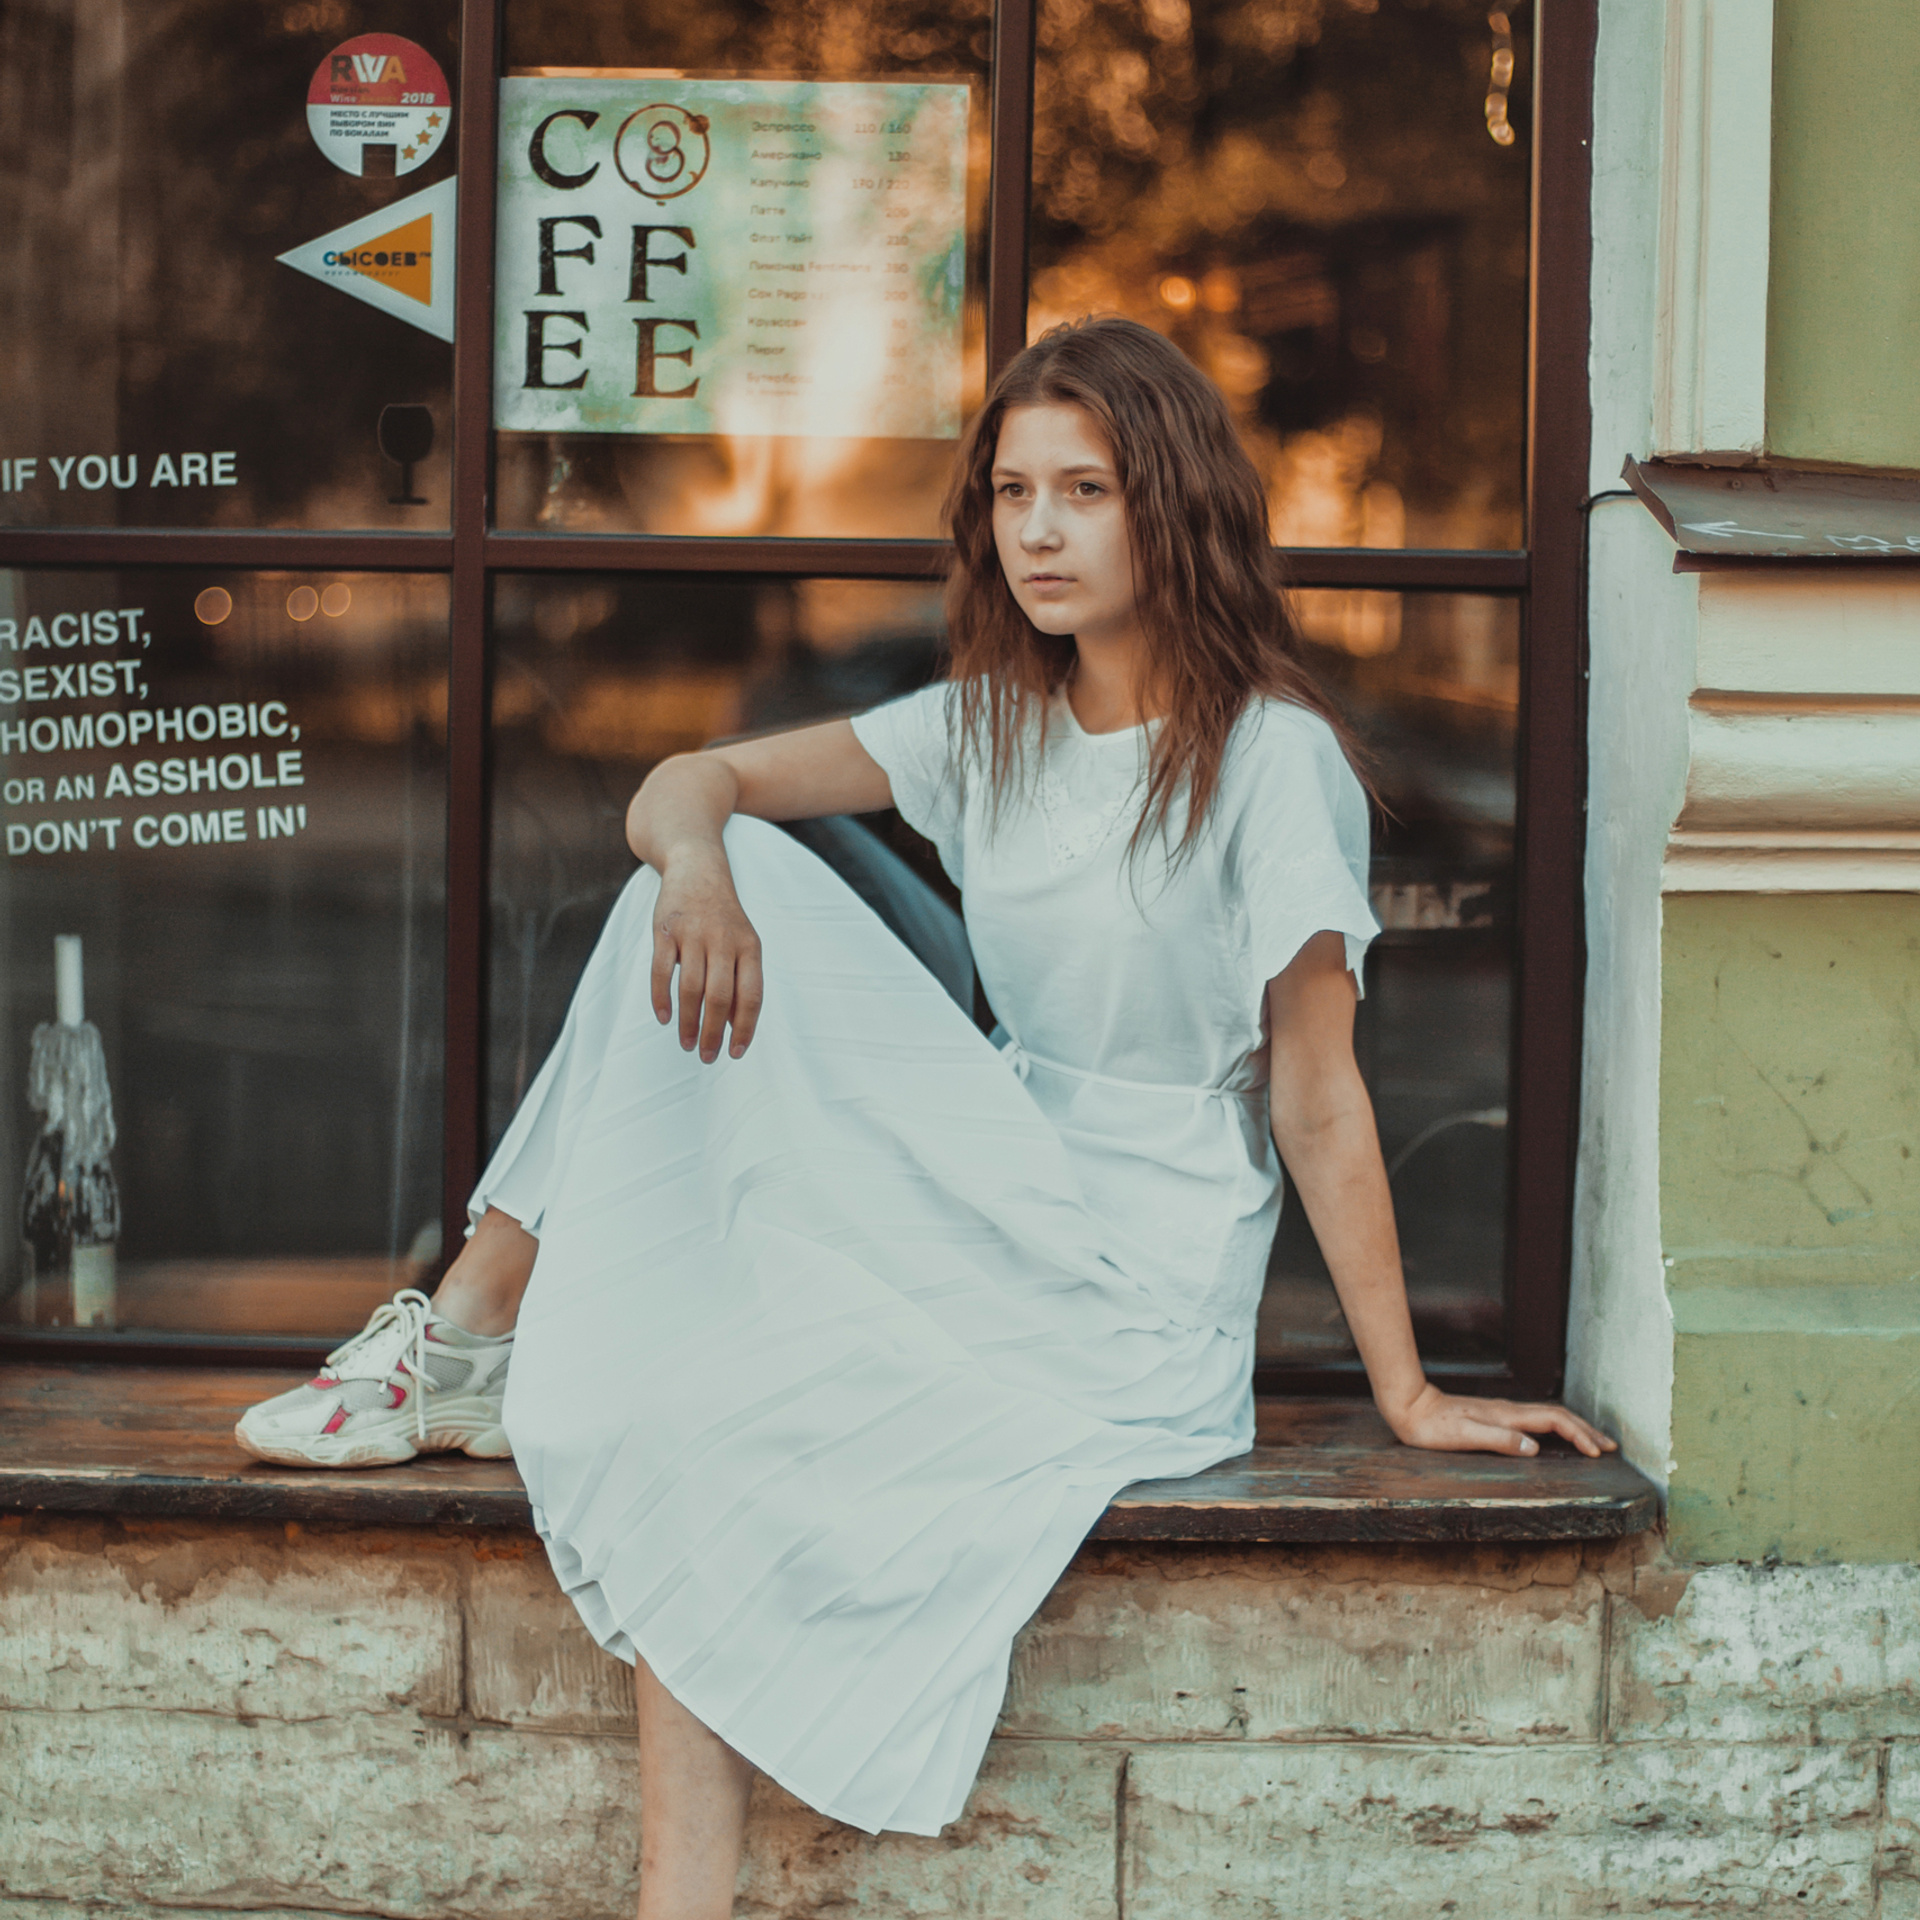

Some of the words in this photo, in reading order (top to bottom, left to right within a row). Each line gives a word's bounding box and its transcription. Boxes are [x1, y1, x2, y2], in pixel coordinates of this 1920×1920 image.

[332, 53, 407, 83] RWA
[401, 92, 436, 104] 2018
[330, 110, 360, 118] МЕСТО
[330, 129, 343, 137] ПО
[344, 129, 389, 137] БОКАЛАМ
[752, 121, 816, 133] Эспрессо
[854, 123, 876, 134] 110
[751, 150, 822, 160] Американо
[750, 178, 810, 189] Капучино
[750, 205, 786, 216] Латте
[2, 458, 37, 492] IF
[50, 454, 138, 490] YOU
[150, 451, 238, 488] ARE
[0, 608, 151, 652] RACIST,
[0, 659, 149, 704] SEXIST,
[1, 701, 301, 755] HOMOPHOBIC,
[3, 778, 45, 805] OR
[54, 774, 95, 801] AN
[104, 750, 305, 799] ASSHOLE
[6, 817, 122, 856] DON'T
[132, 809, 247, 849] COME
